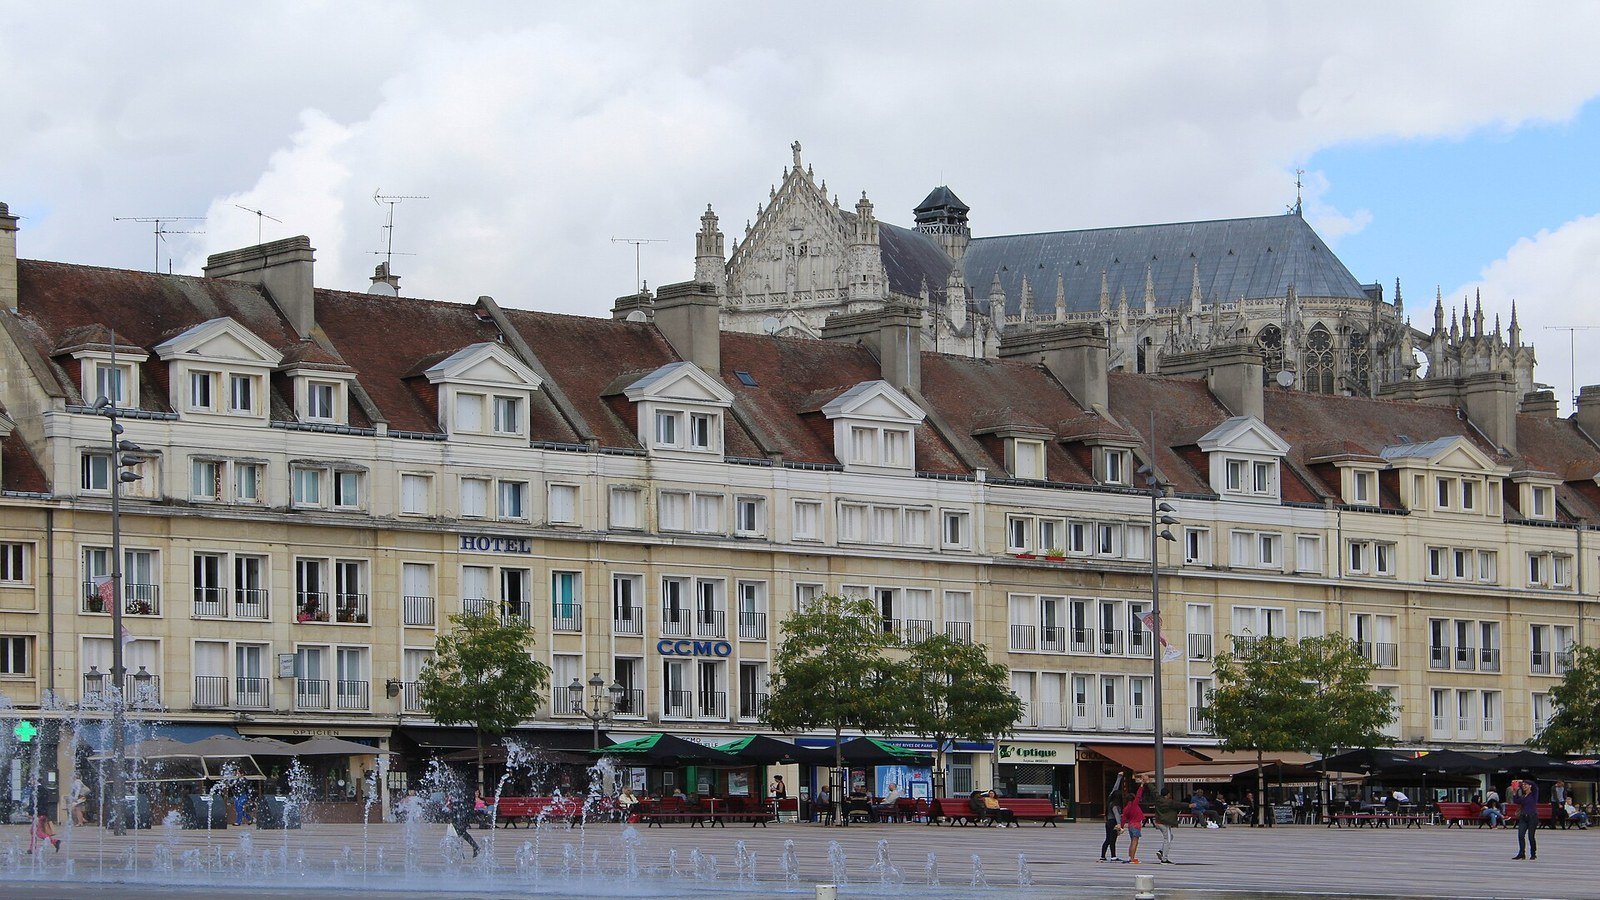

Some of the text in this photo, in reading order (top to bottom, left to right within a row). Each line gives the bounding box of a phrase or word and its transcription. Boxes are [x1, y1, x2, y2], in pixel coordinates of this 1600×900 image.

[460, 535, 531, 554] HOTEL
[657, 640, 732, 657] CCMO
[1016, 747, 1057, 758] Optique
